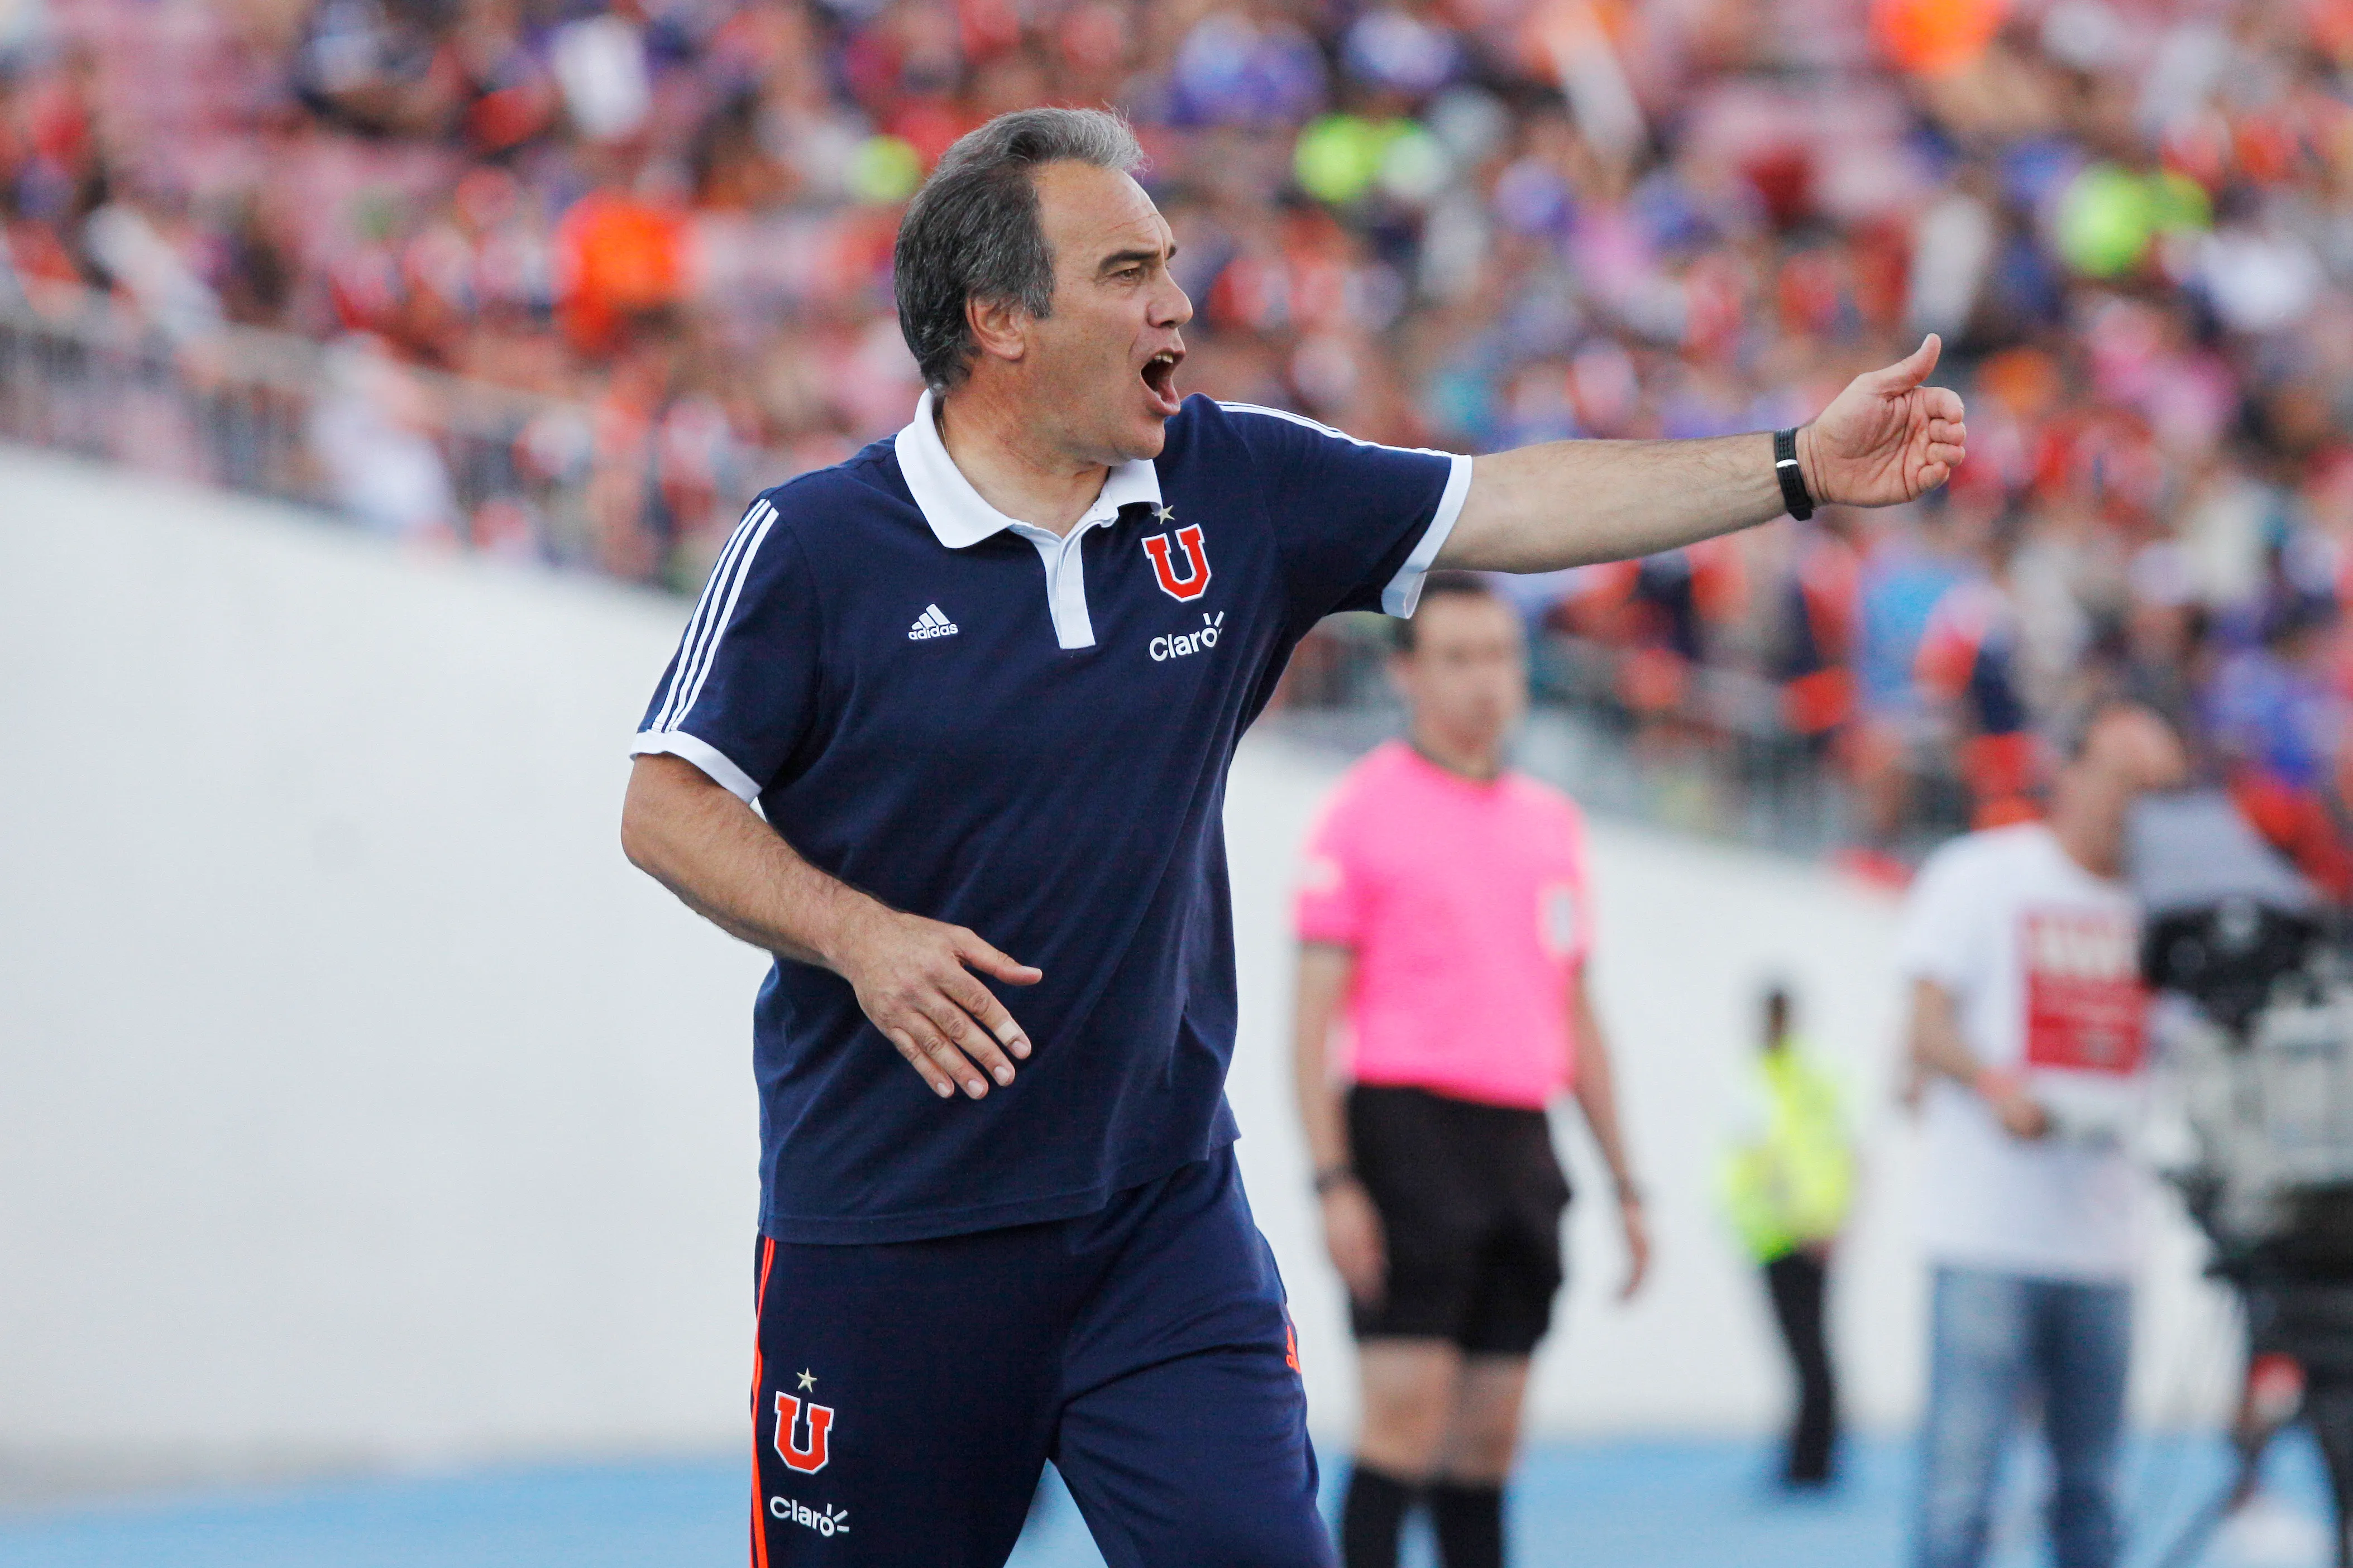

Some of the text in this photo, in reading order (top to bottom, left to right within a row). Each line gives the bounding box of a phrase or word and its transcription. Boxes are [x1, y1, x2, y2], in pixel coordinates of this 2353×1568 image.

[1142, 523, 1212, 602] U
[908, 620, 959, 640] adidas
[1149, 625, 1219, 661] Claro
[774, 1390, 835, 1475] U
[770, 1496, 836, 1537] Claro
